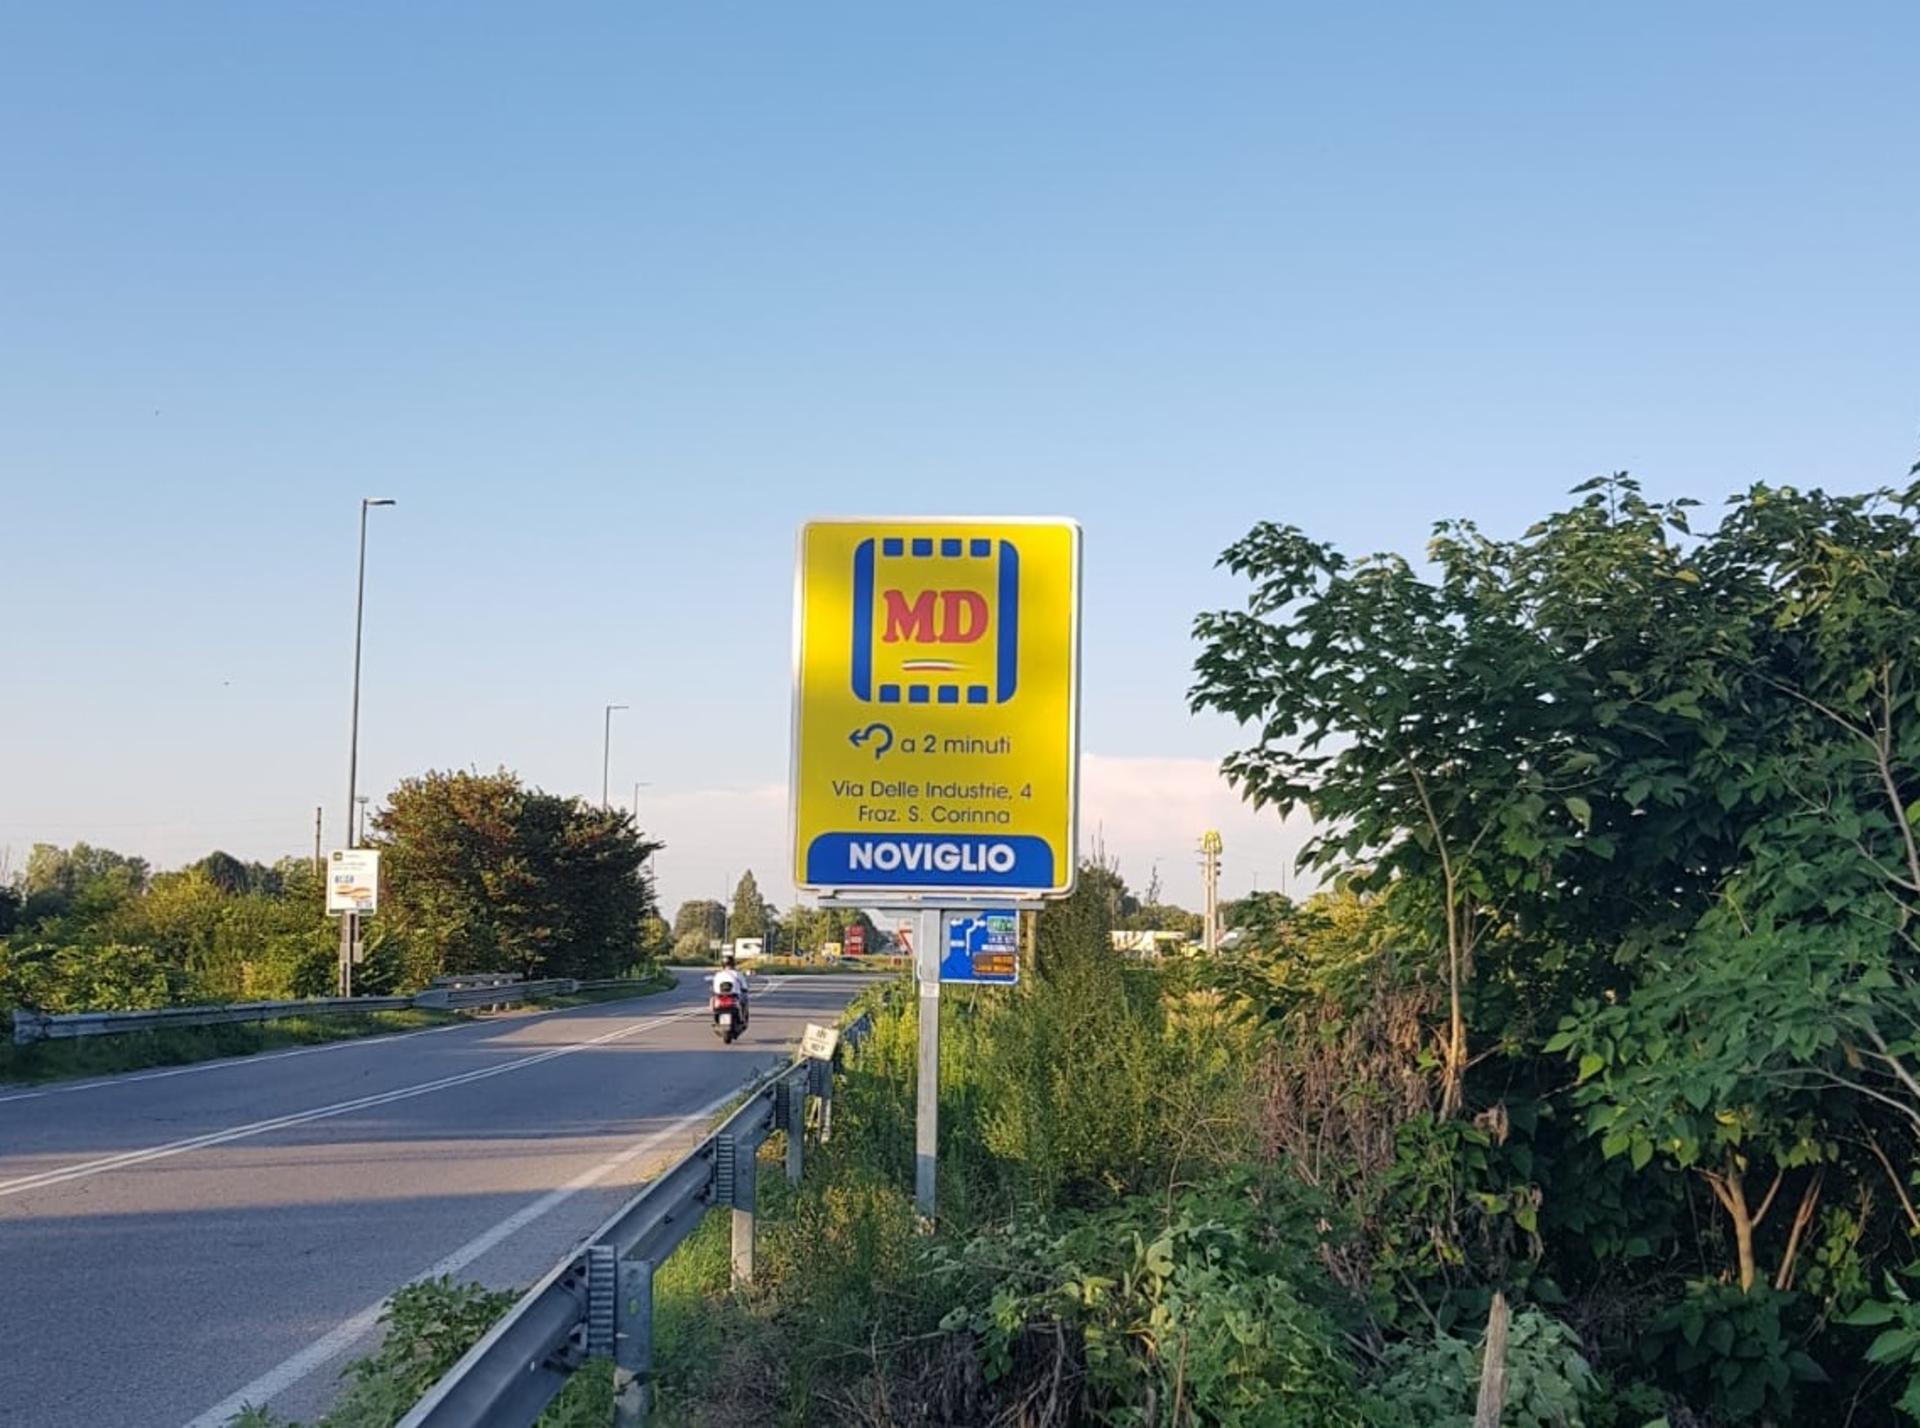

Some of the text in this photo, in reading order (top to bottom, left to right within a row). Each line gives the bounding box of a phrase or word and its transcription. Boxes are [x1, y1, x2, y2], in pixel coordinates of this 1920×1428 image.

[882, 589, 989, 644] MD
[900, 734, 1011, 755] a 2 minuti
[832, 780, 864, 798] Via
[870, 780, 919, 798] Delle
[1020, 783, 1032, 799] 4
[858, 804, 1011, 824] Fraz. S. Corinna
[849, 841, 1016, 873] NOVIGLIO
